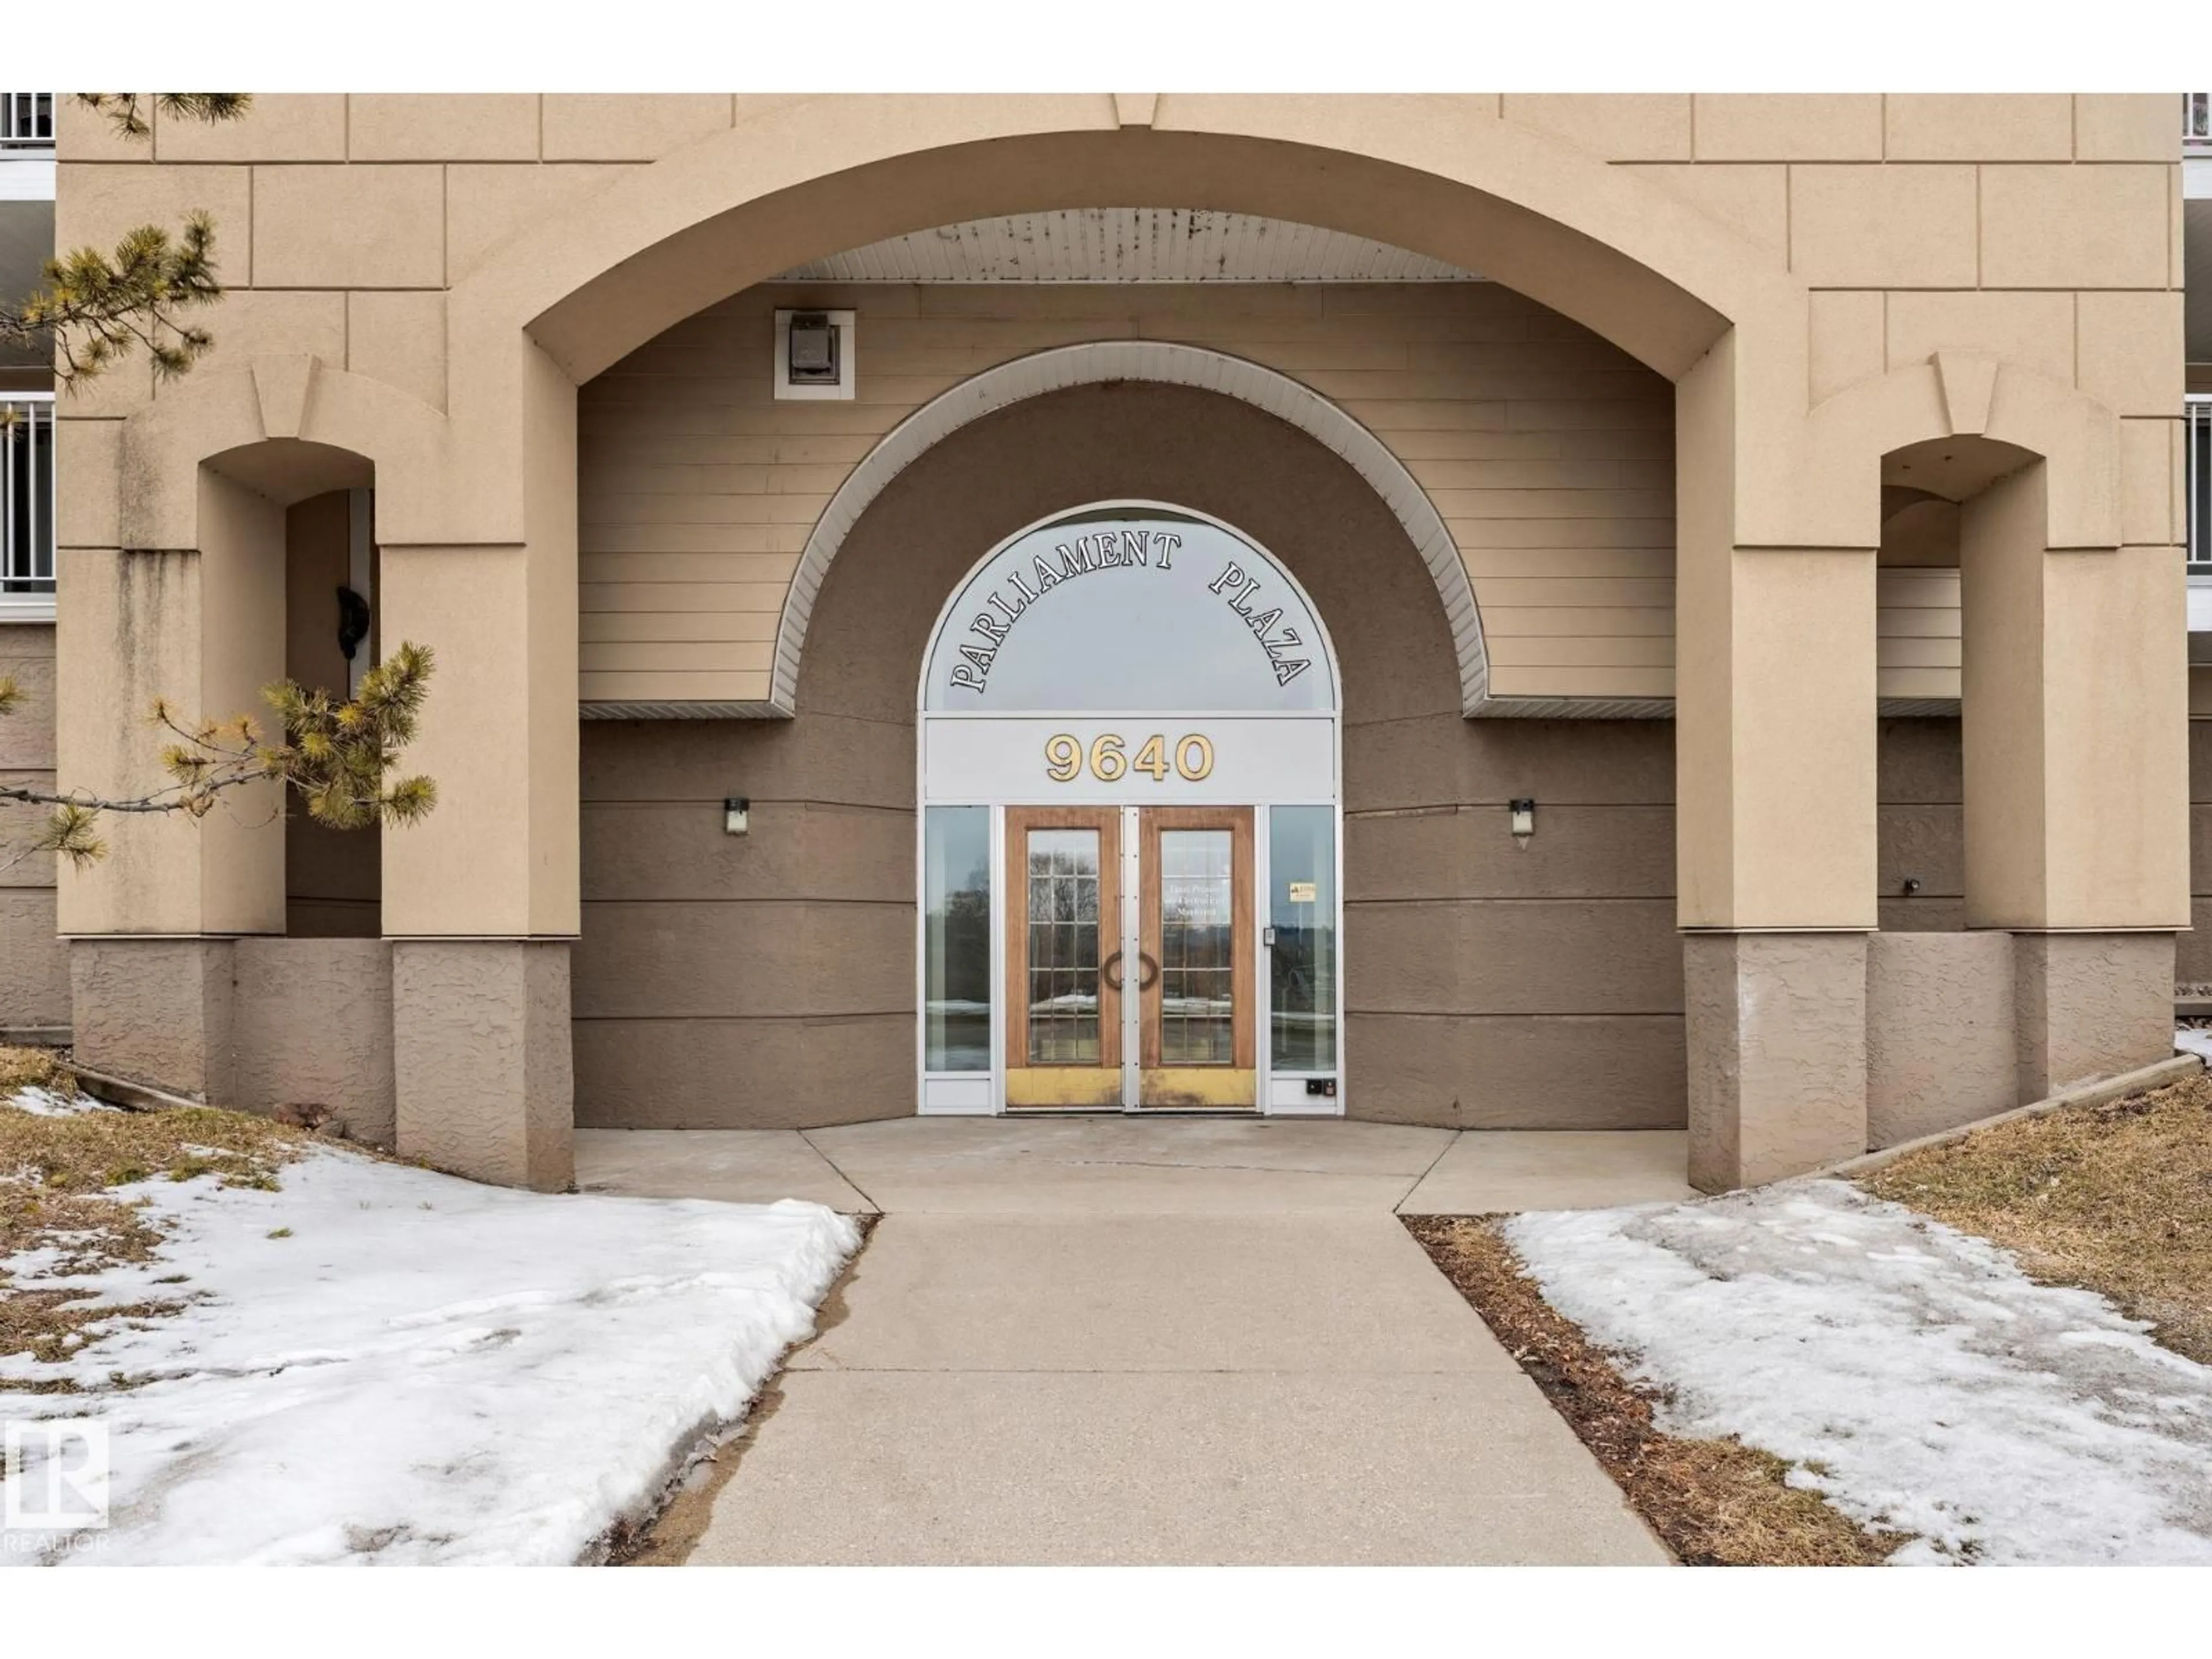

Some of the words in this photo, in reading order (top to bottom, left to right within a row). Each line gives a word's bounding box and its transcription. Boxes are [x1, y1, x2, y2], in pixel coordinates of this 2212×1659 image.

[950, 531, 1181, 693] PARLIAMENT
[1209, 562, 1312, 686] PLAZA
[1045, 734, 1214, 782] 9640
